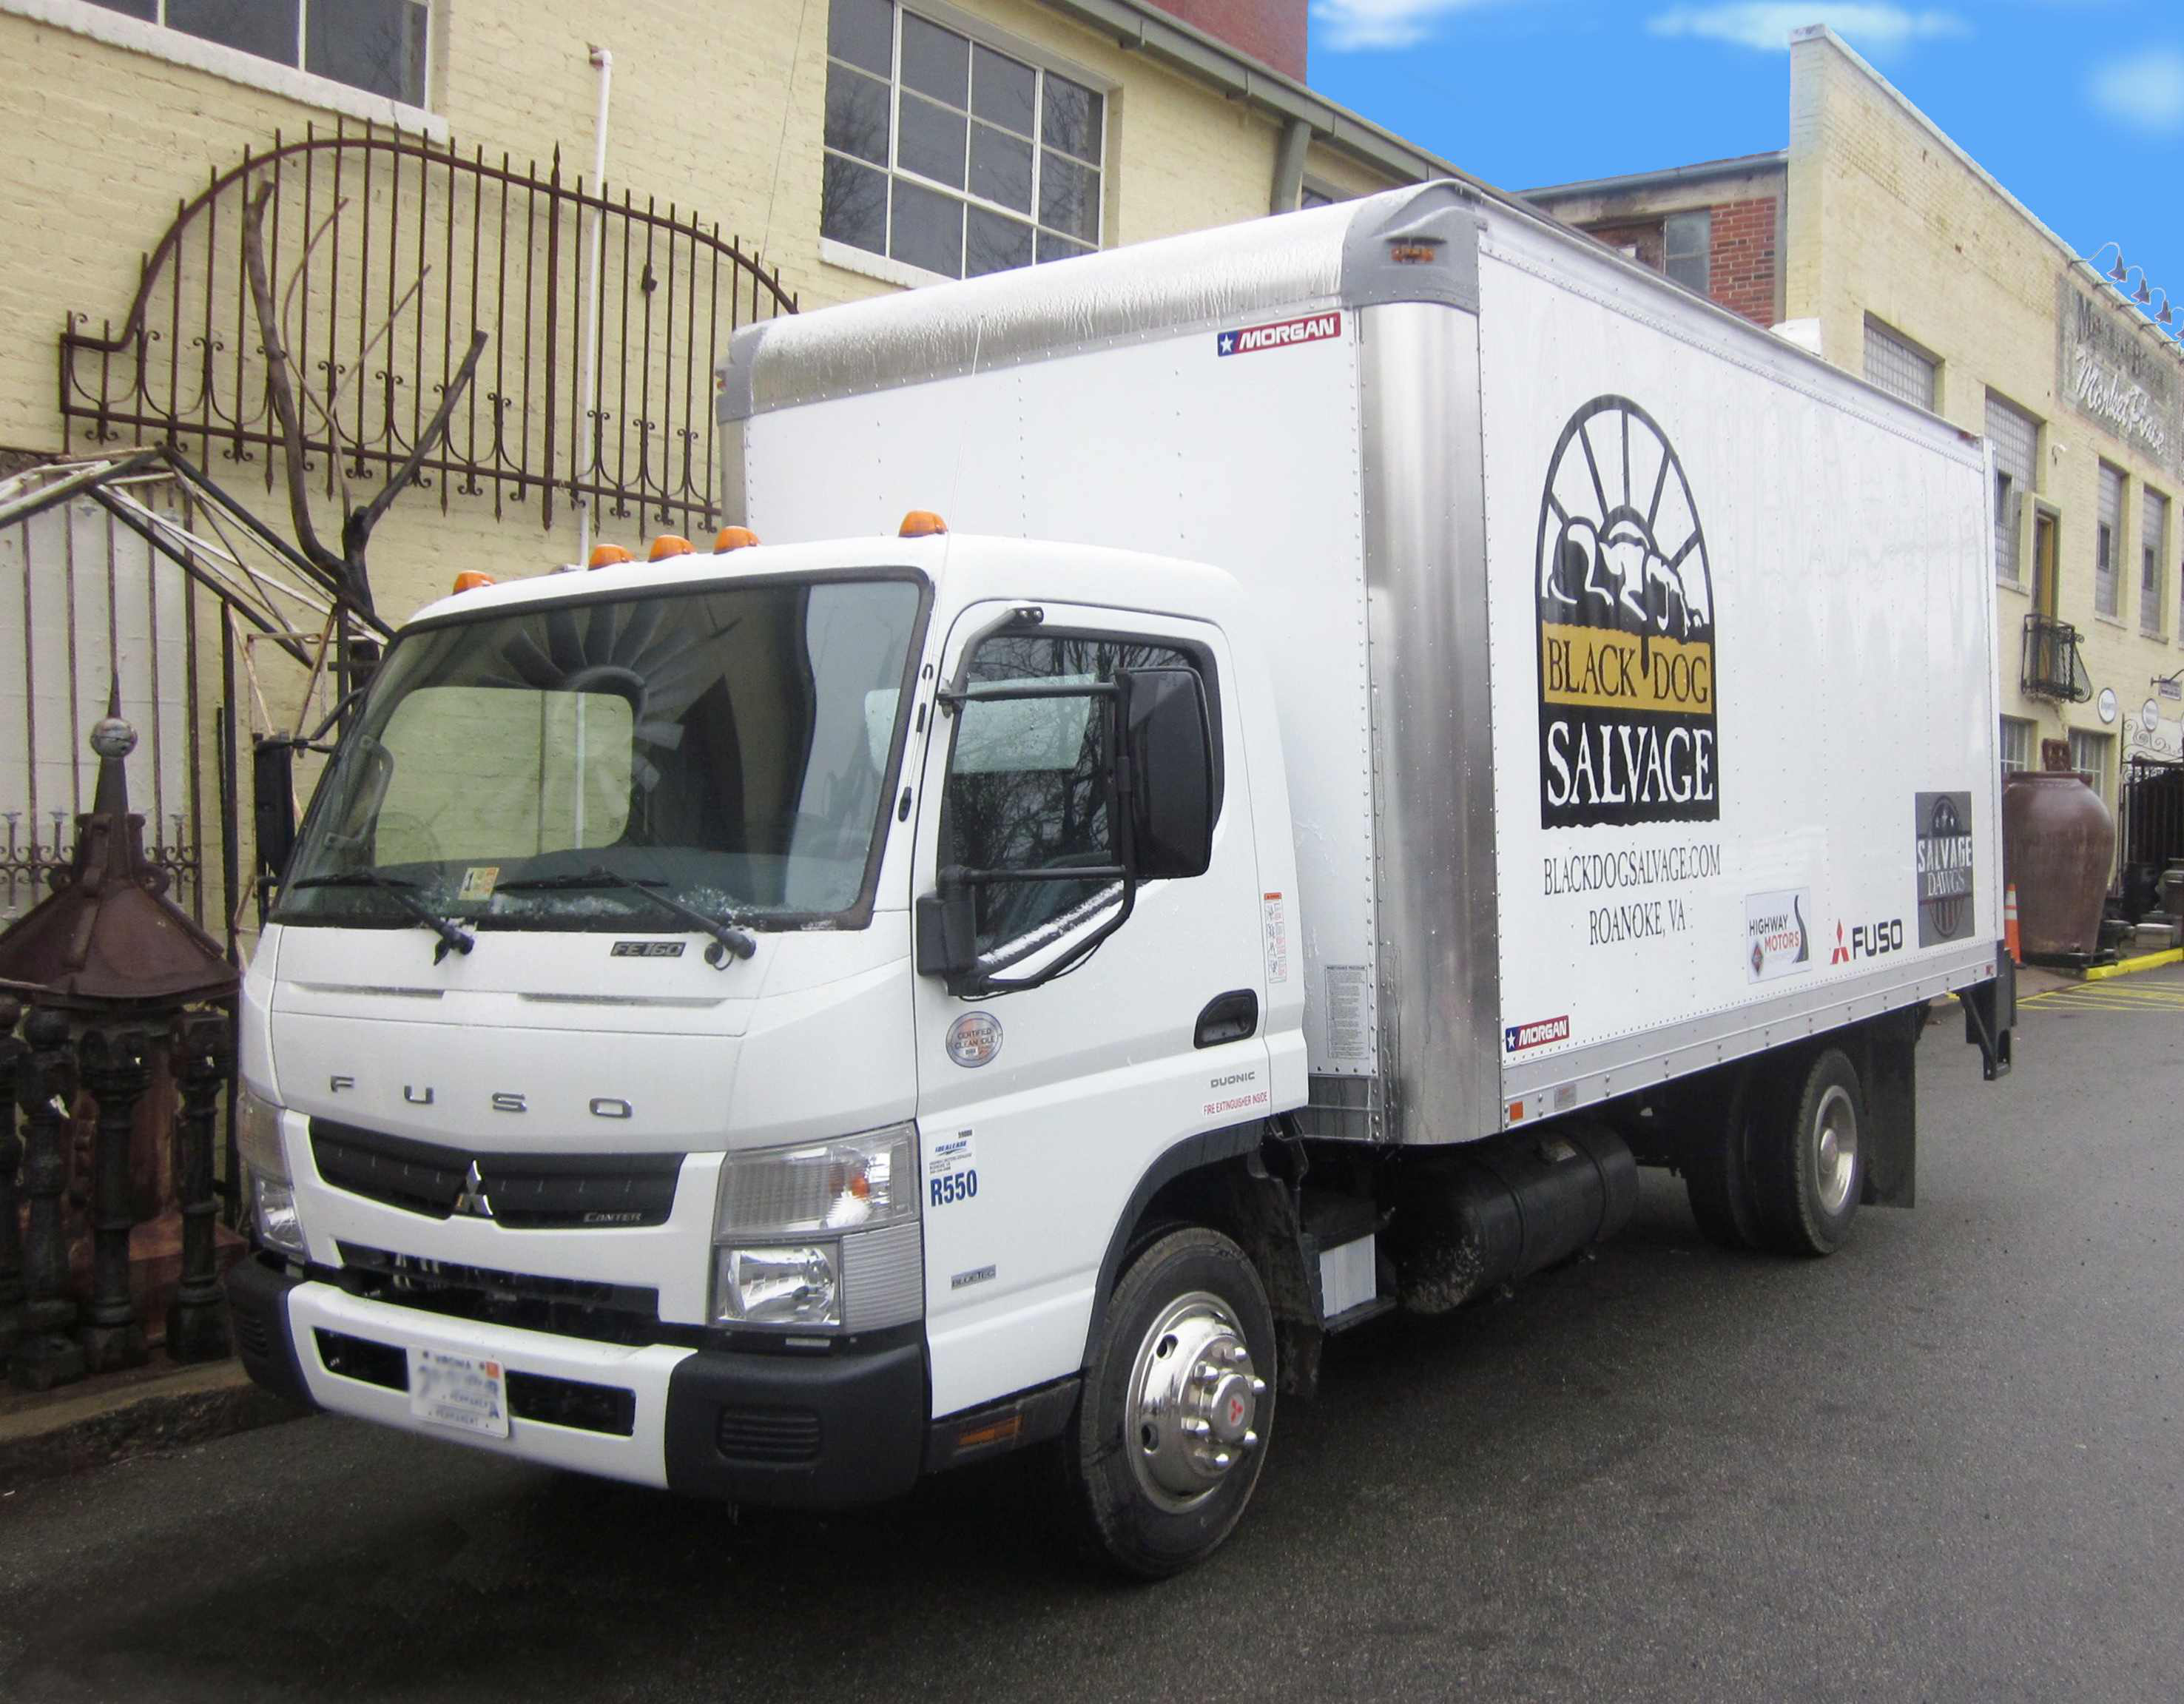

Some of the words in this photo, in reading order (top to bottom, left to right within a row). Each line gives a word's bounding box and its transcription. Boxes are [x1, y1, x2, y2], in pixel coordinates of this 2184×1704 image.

[1238, 317, 1335, 350] MORGAN
[1547, 636, 1637, 697] BLACK
[1652, 651, 1708, 704] DOG
[1547, 721, 1713, 806] SALVAGE
[1543, 844, 1722, 895] BLACKDOGSALVAGE.COM
[1918, 836, 1972, 873] SALVAGE
[1927, 870, 1965, 896] DAWGS
[1589, 902, 1665, 946] ROANOKE,
[1668, 898, 1686, 932] VA
[1749, 915, 1789, 936] HIGHWAY
[1852, 919, 1904, 960] FUSO
[1765, 931, 1800, 953] MOTORS
[1518, 1020, 1568, 1047] MORGAN
[330, 1075, 633, 1119] FUSO
[1210, 1071, 1256, 1088] DUONIC
[1203, 1103, 1216, 1115] FIRE
[1253, 1091, 1268, 1105] INSIDE
[930, 1169, 977, 1208] R550
